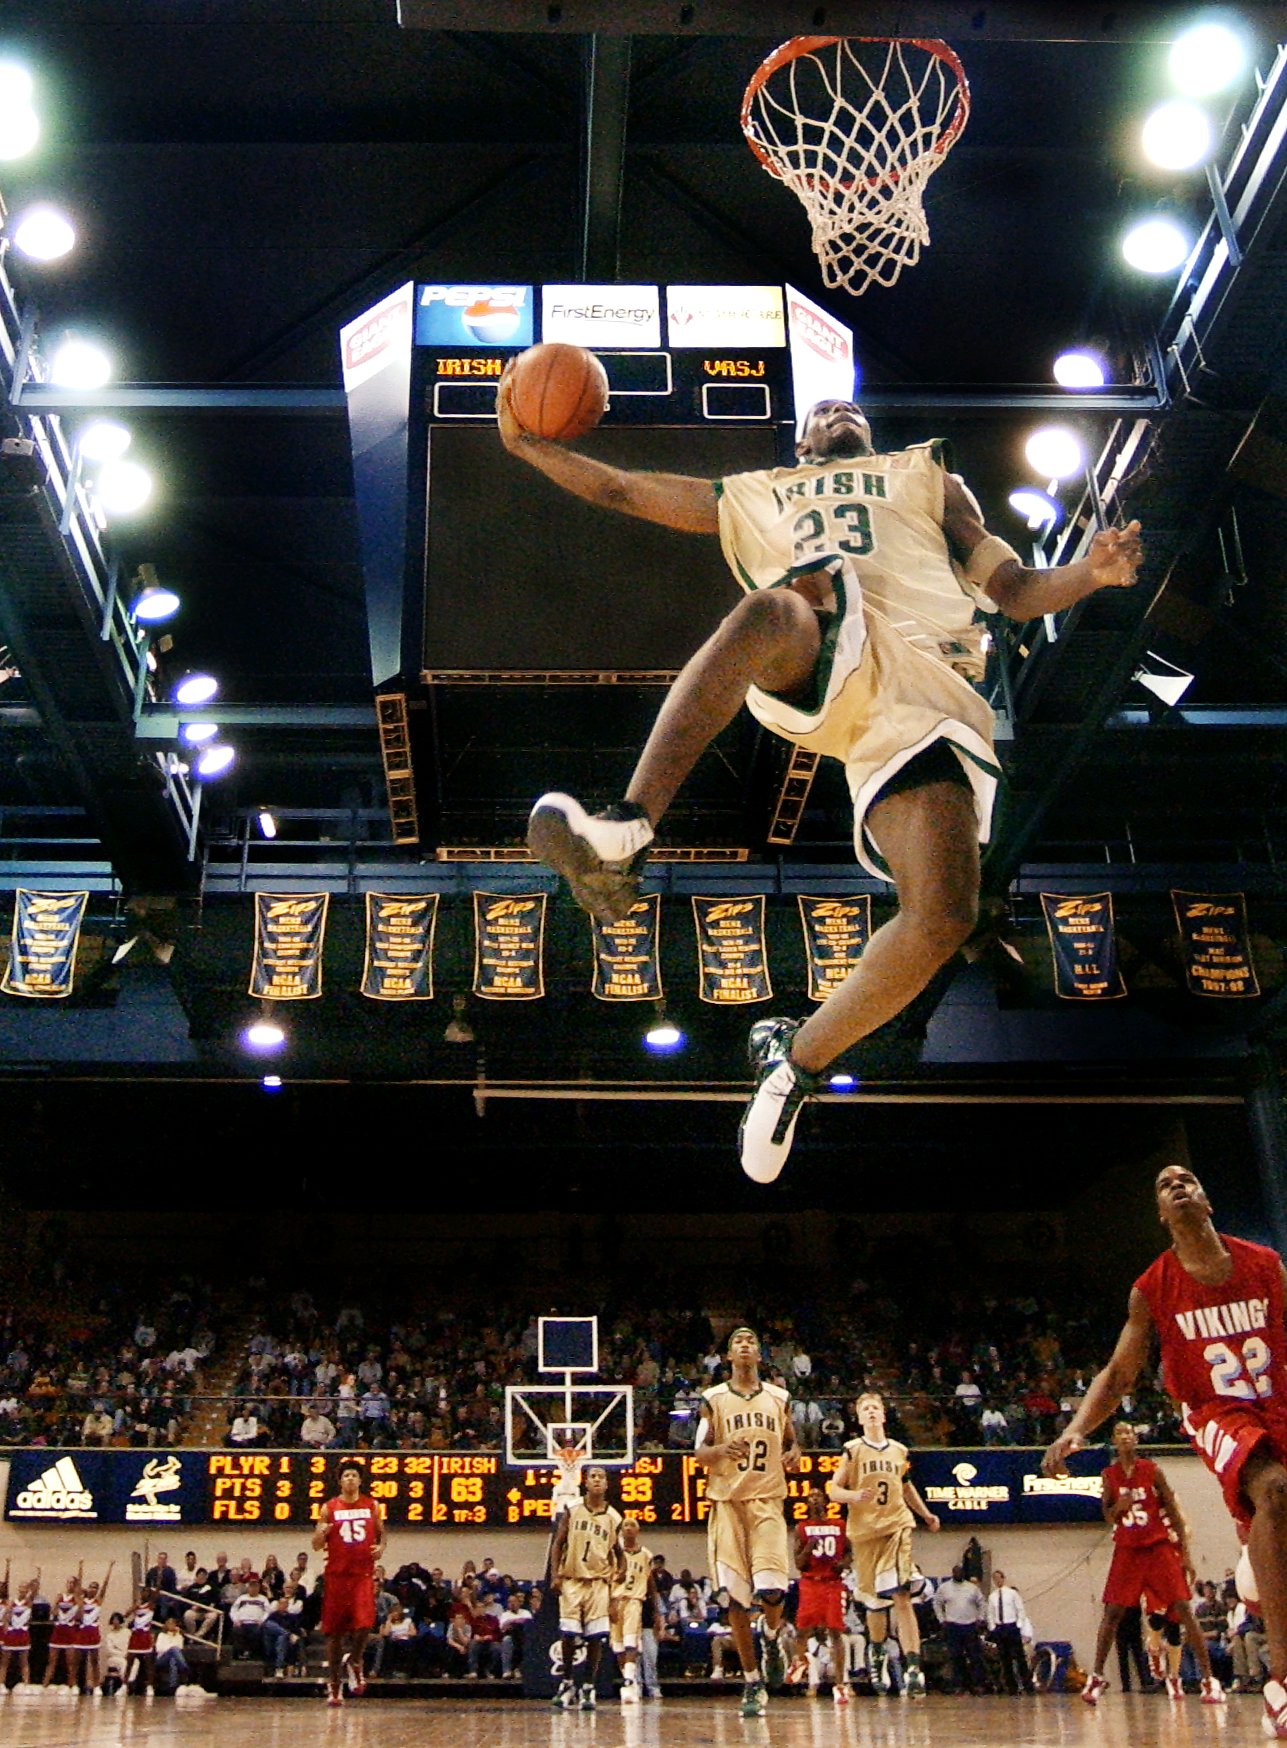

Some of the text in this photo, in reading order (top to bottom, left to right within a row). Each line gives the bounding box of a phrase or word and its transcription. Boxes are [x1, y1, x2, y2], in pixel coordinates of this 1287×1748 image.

[421, 286, 527, 307] PEPSI
[549, 304, 656, 325] FirstEnergy
[436, 358, 502, 375] IRISH
[793, 503, 875, 560] 23
[1203, 1336, 1273, 1399] 22
[726, 1411, 776, 1433] IRISH
[209, 1455, 271, 1475] PLYR
[279, 1456, 291, 1473] 1
[310, 1456, 327, 1474] 3
[370, 1457, 399, 1474] 23
[404, 1457, 432, 1474] 32
[441, 1457, 498, 1474] IRISH
[214, 1478, 425, 1499] PTS 3 2 30 3
[450, 1477, 484, 1502] 63
[621, 1477, 653, 1502] 33
[877, 1480, 889, 1506] 3
[924, 1486, 1010, 1500] TIME WARNER
[16, 1492, 94, 1510] adidas
[213, 1500, 261, 1520] FLS
[274, 1502, 290, 1520] 0
[309, 1503, 322, 1520] 1
[408, 1503, 424, 1520] 2
[437, 1503, 449, 1520] 2
[671, 1503, 682, 1520] 2
[793, 1502, 842, 1519] 2 2
[947, 1500, 989, 1510] CABLE
[339, 1520, 367, 1544] 45
[582, 1540, 591, 1563] 1
